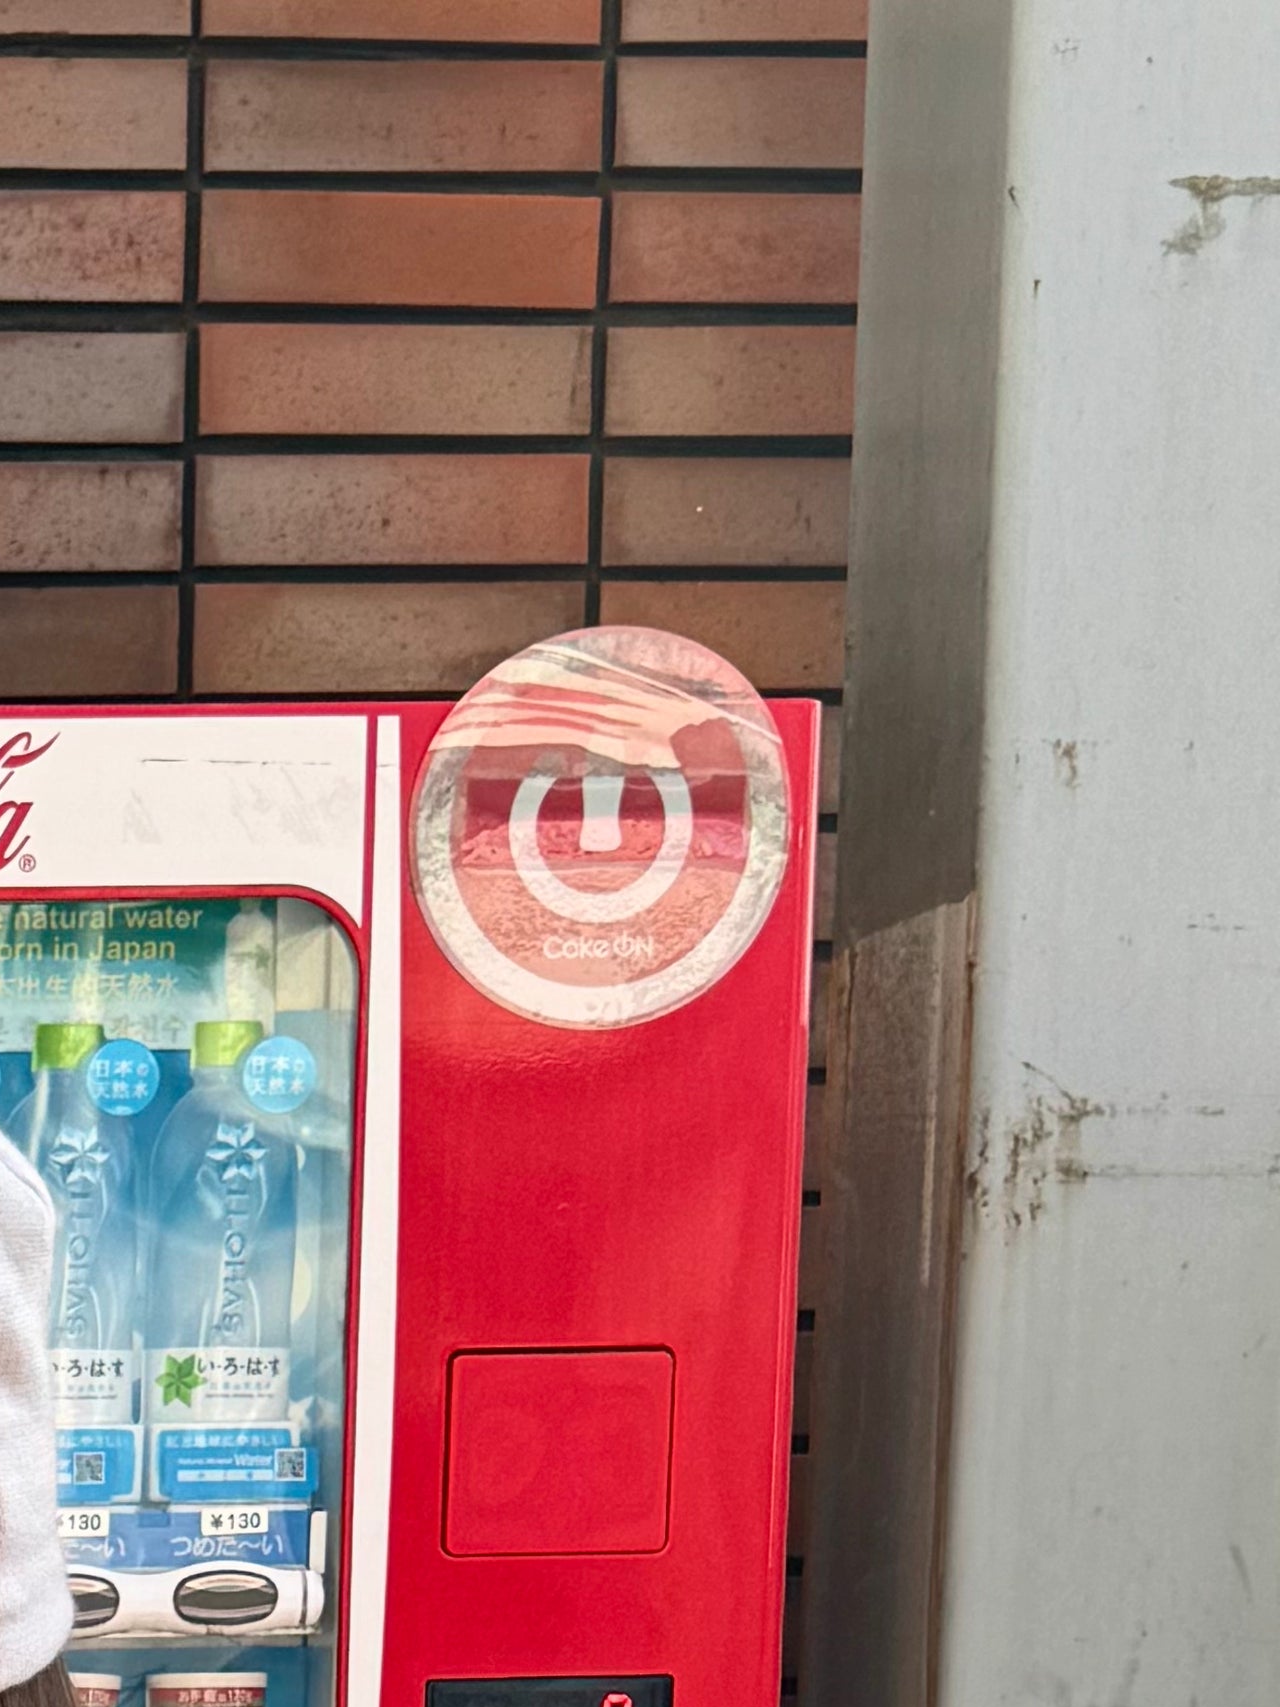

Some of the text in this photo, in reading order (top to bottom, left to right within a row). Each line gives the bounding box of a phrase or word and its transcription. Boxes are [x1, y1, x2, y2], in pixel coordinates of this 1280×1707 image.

[15, 906, 113, 930] natural
[125, 909, 203, 930] water
[53, 939, 78, 960] in
[89, 938, 176, 964] Japan
[95, 1058, 149, 1078] 日本の
[251, 1056, 304, 1075] 日本の
[91, 1079, 147, 1099] 天然水
[250, 1076, 304, 1096] 天然水
[210, 1512, 262, 1530] ¥130
